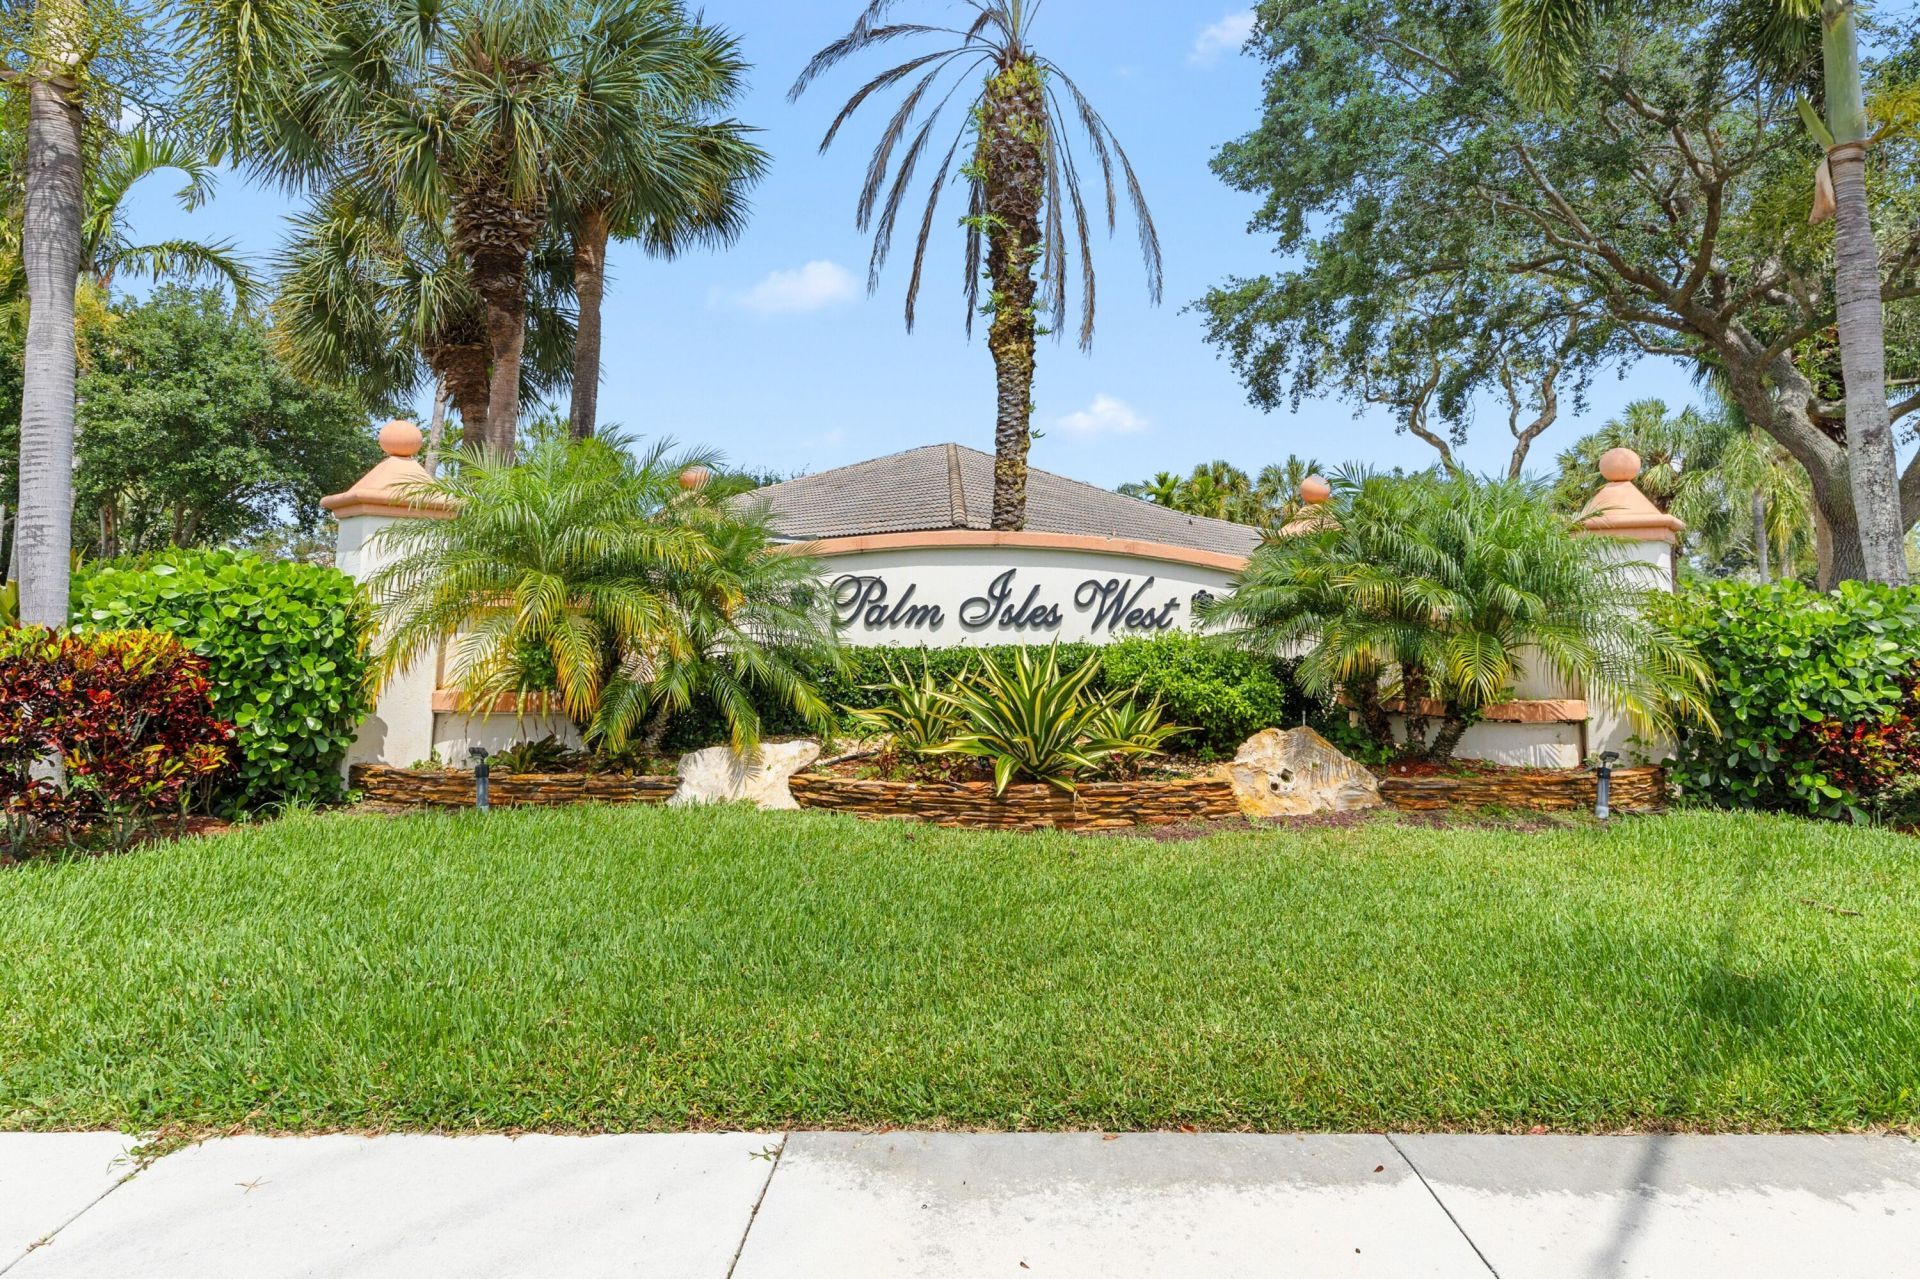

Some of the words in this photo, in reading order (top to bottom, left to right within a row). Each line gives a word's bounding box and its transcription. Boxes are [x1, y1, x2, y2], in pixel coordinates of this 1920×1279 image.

[831, 574, 945, 628] Palm
[959, 568, 1063, 627] Isles
[1074, 576, 1180, 633] West
